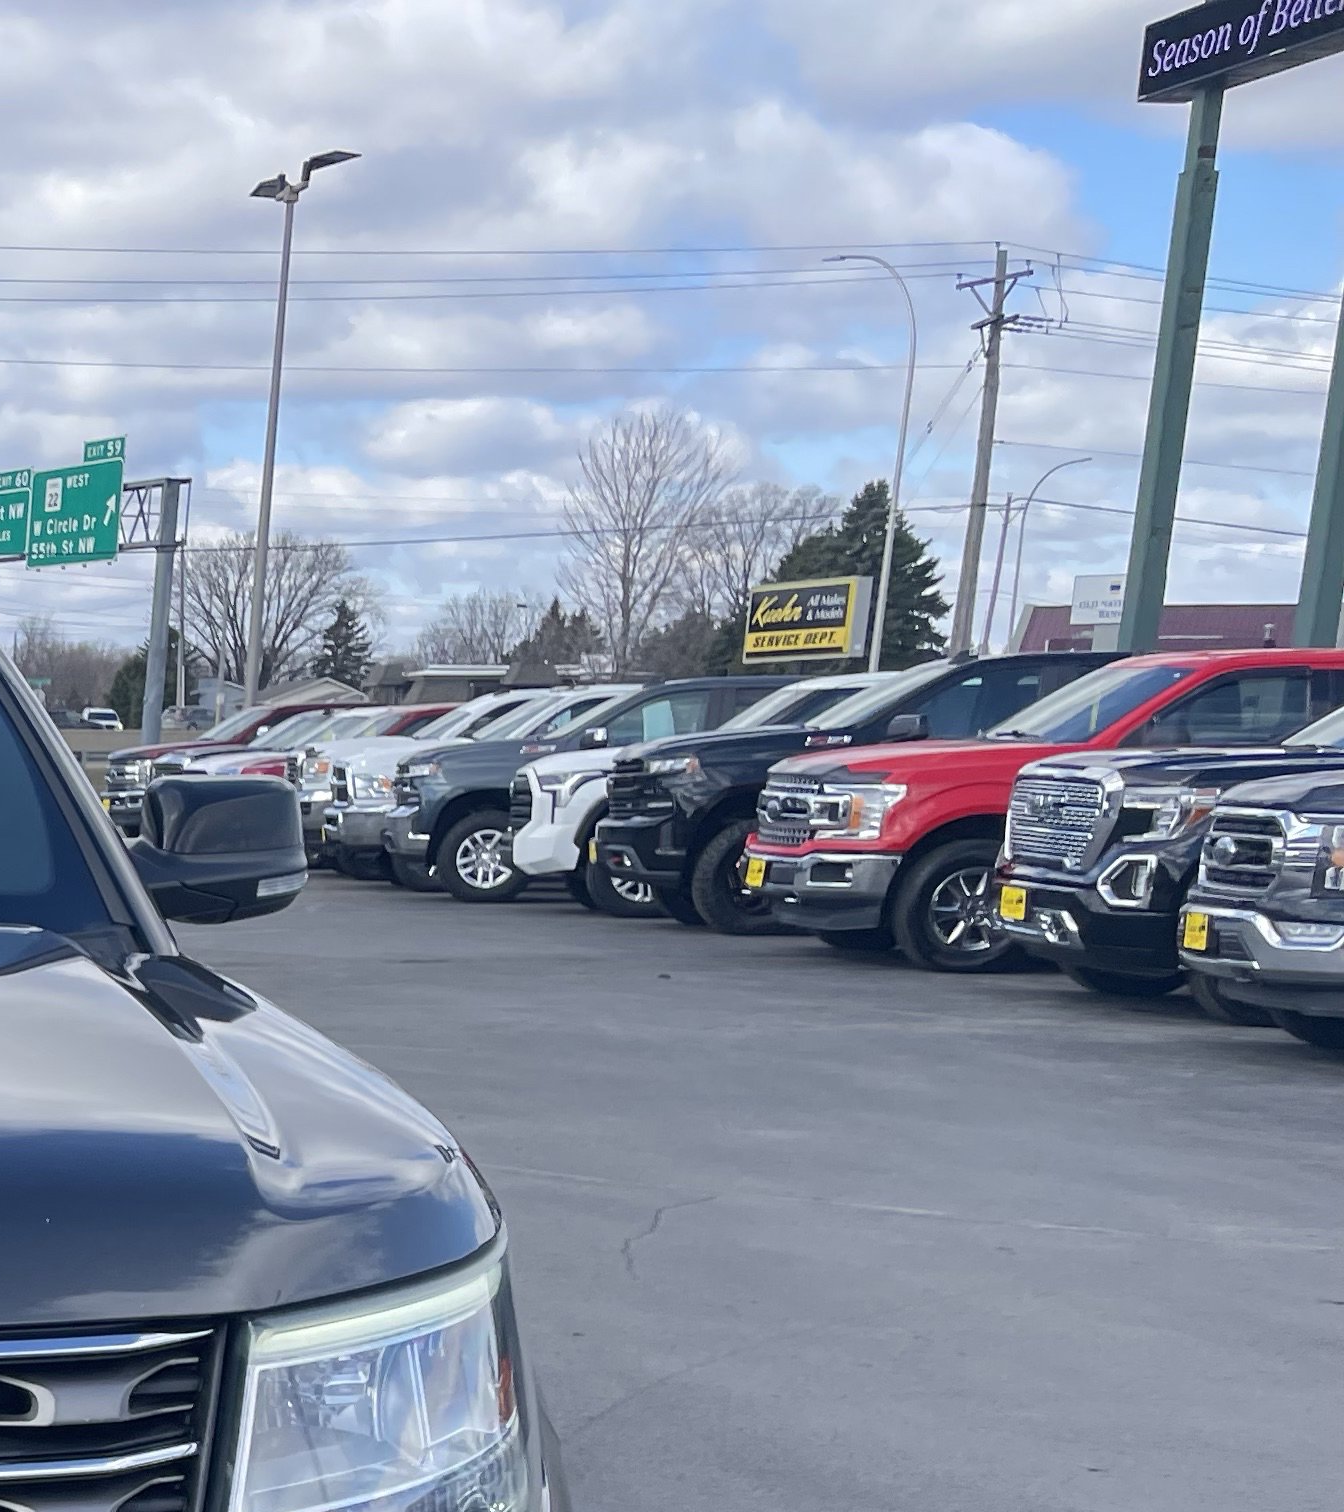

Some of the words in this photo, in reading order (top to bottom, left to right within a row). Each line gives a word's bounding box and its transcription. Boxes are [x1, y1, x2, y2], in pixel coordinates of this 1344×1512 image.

[1148, 22, 1232, 77] Season
[1239, 0, 1272, 55] of
[86, 444, 105, 458] EXIT
[107, 440, 122, 457] 59
[15, 471, 29, 487] 60
[66, 473, 90, 489] WEST
[47, 492, 59, 508] 22
[8, 502, 25, 520] NW
[33, 520, 42, 537] W
[46, 517, 79, 535] Circle
[83, 514, 97, 531] Dr
[31, 542, 57, 560] 55th
[61, 540, 74, 554] St
[78, 536, 96, 554] NW
[752, 593, 802, 628] Kuehn
[753, 634, 802, 649] SERVICE
